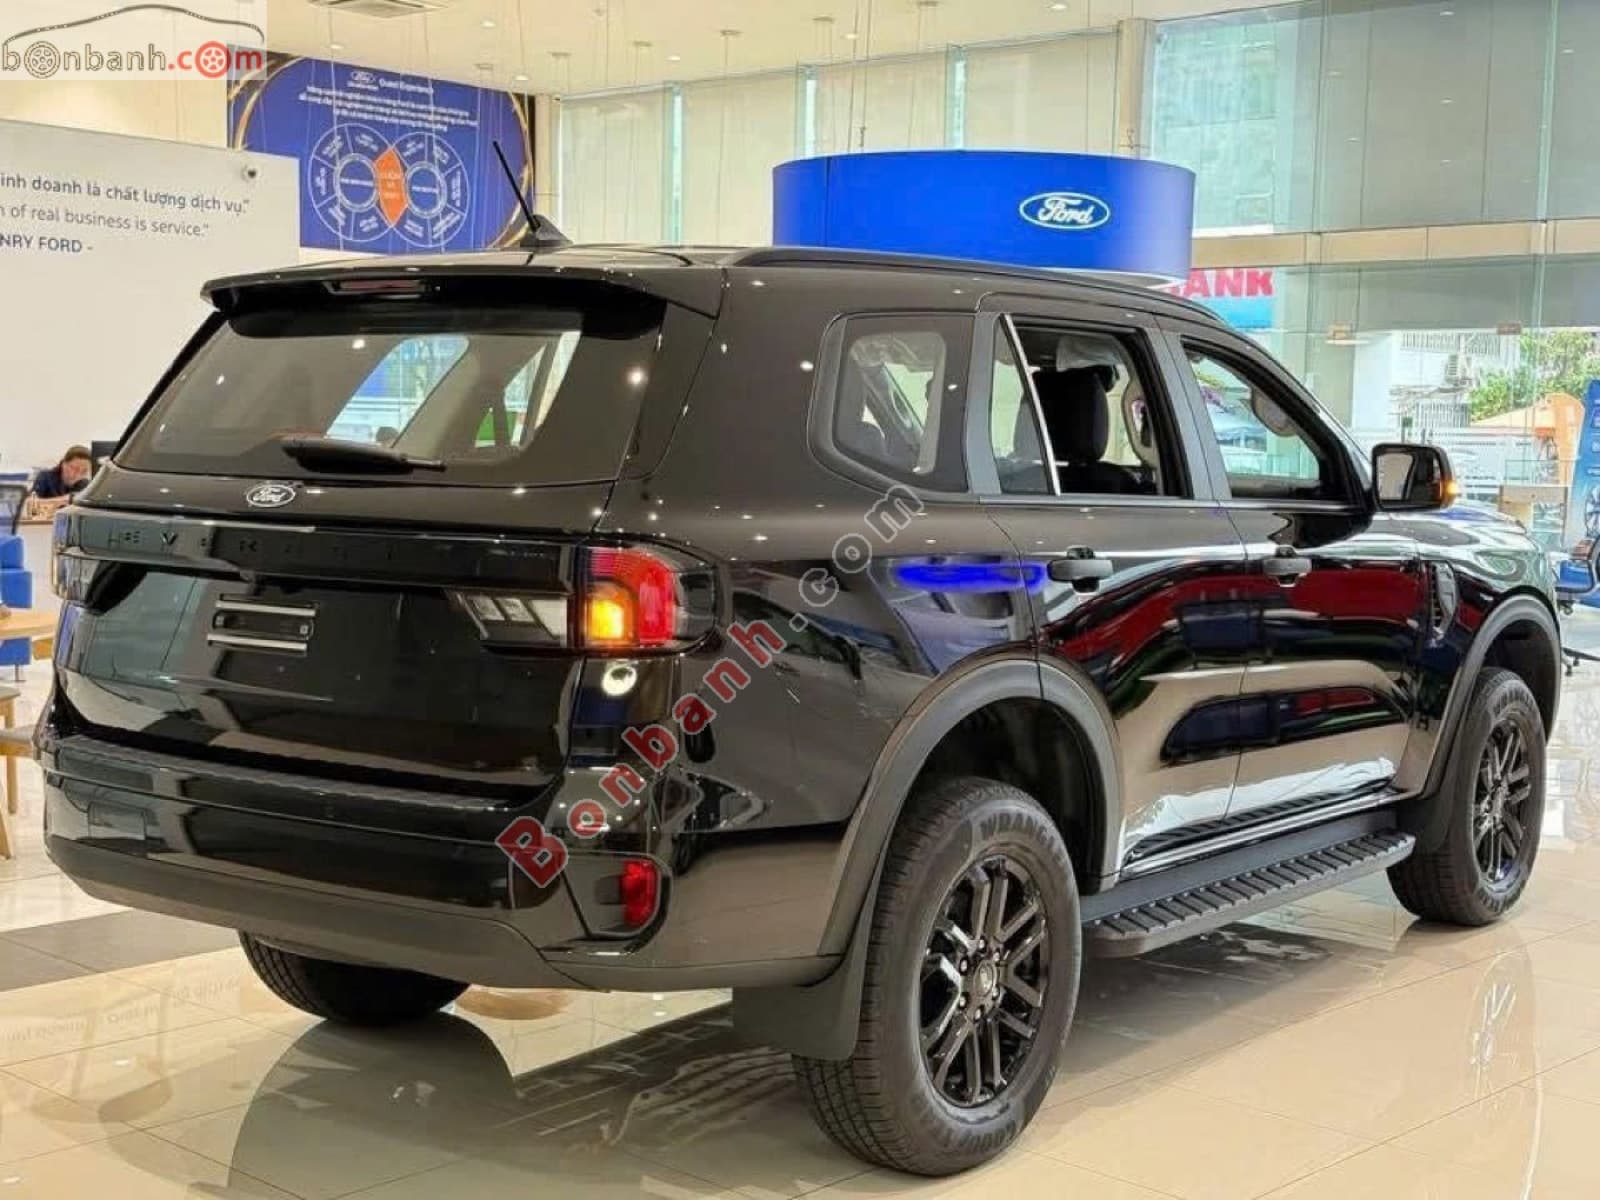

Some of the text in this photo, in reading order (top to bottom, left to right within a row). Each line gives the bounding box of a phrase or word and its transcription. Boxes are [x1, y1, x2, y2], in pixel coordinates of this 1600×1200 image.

[0, 173, 26, 188] inh
[32, 176, 82, 194] doanh
[87, 181, 101, 196] là
[191, 194, 221, 212] dịch
[11, 204, 27, 218] of
[31, 207, 60, 222] real
[65, 208, 131, 229] business
[135, 215, 147, 231] is
[1037, 195, 1095, 225] Ford
[0, 233, 33, 248] NRY
[38, 236, 83, 253] FORD
[1170, 269, 1274, 297] ANK
